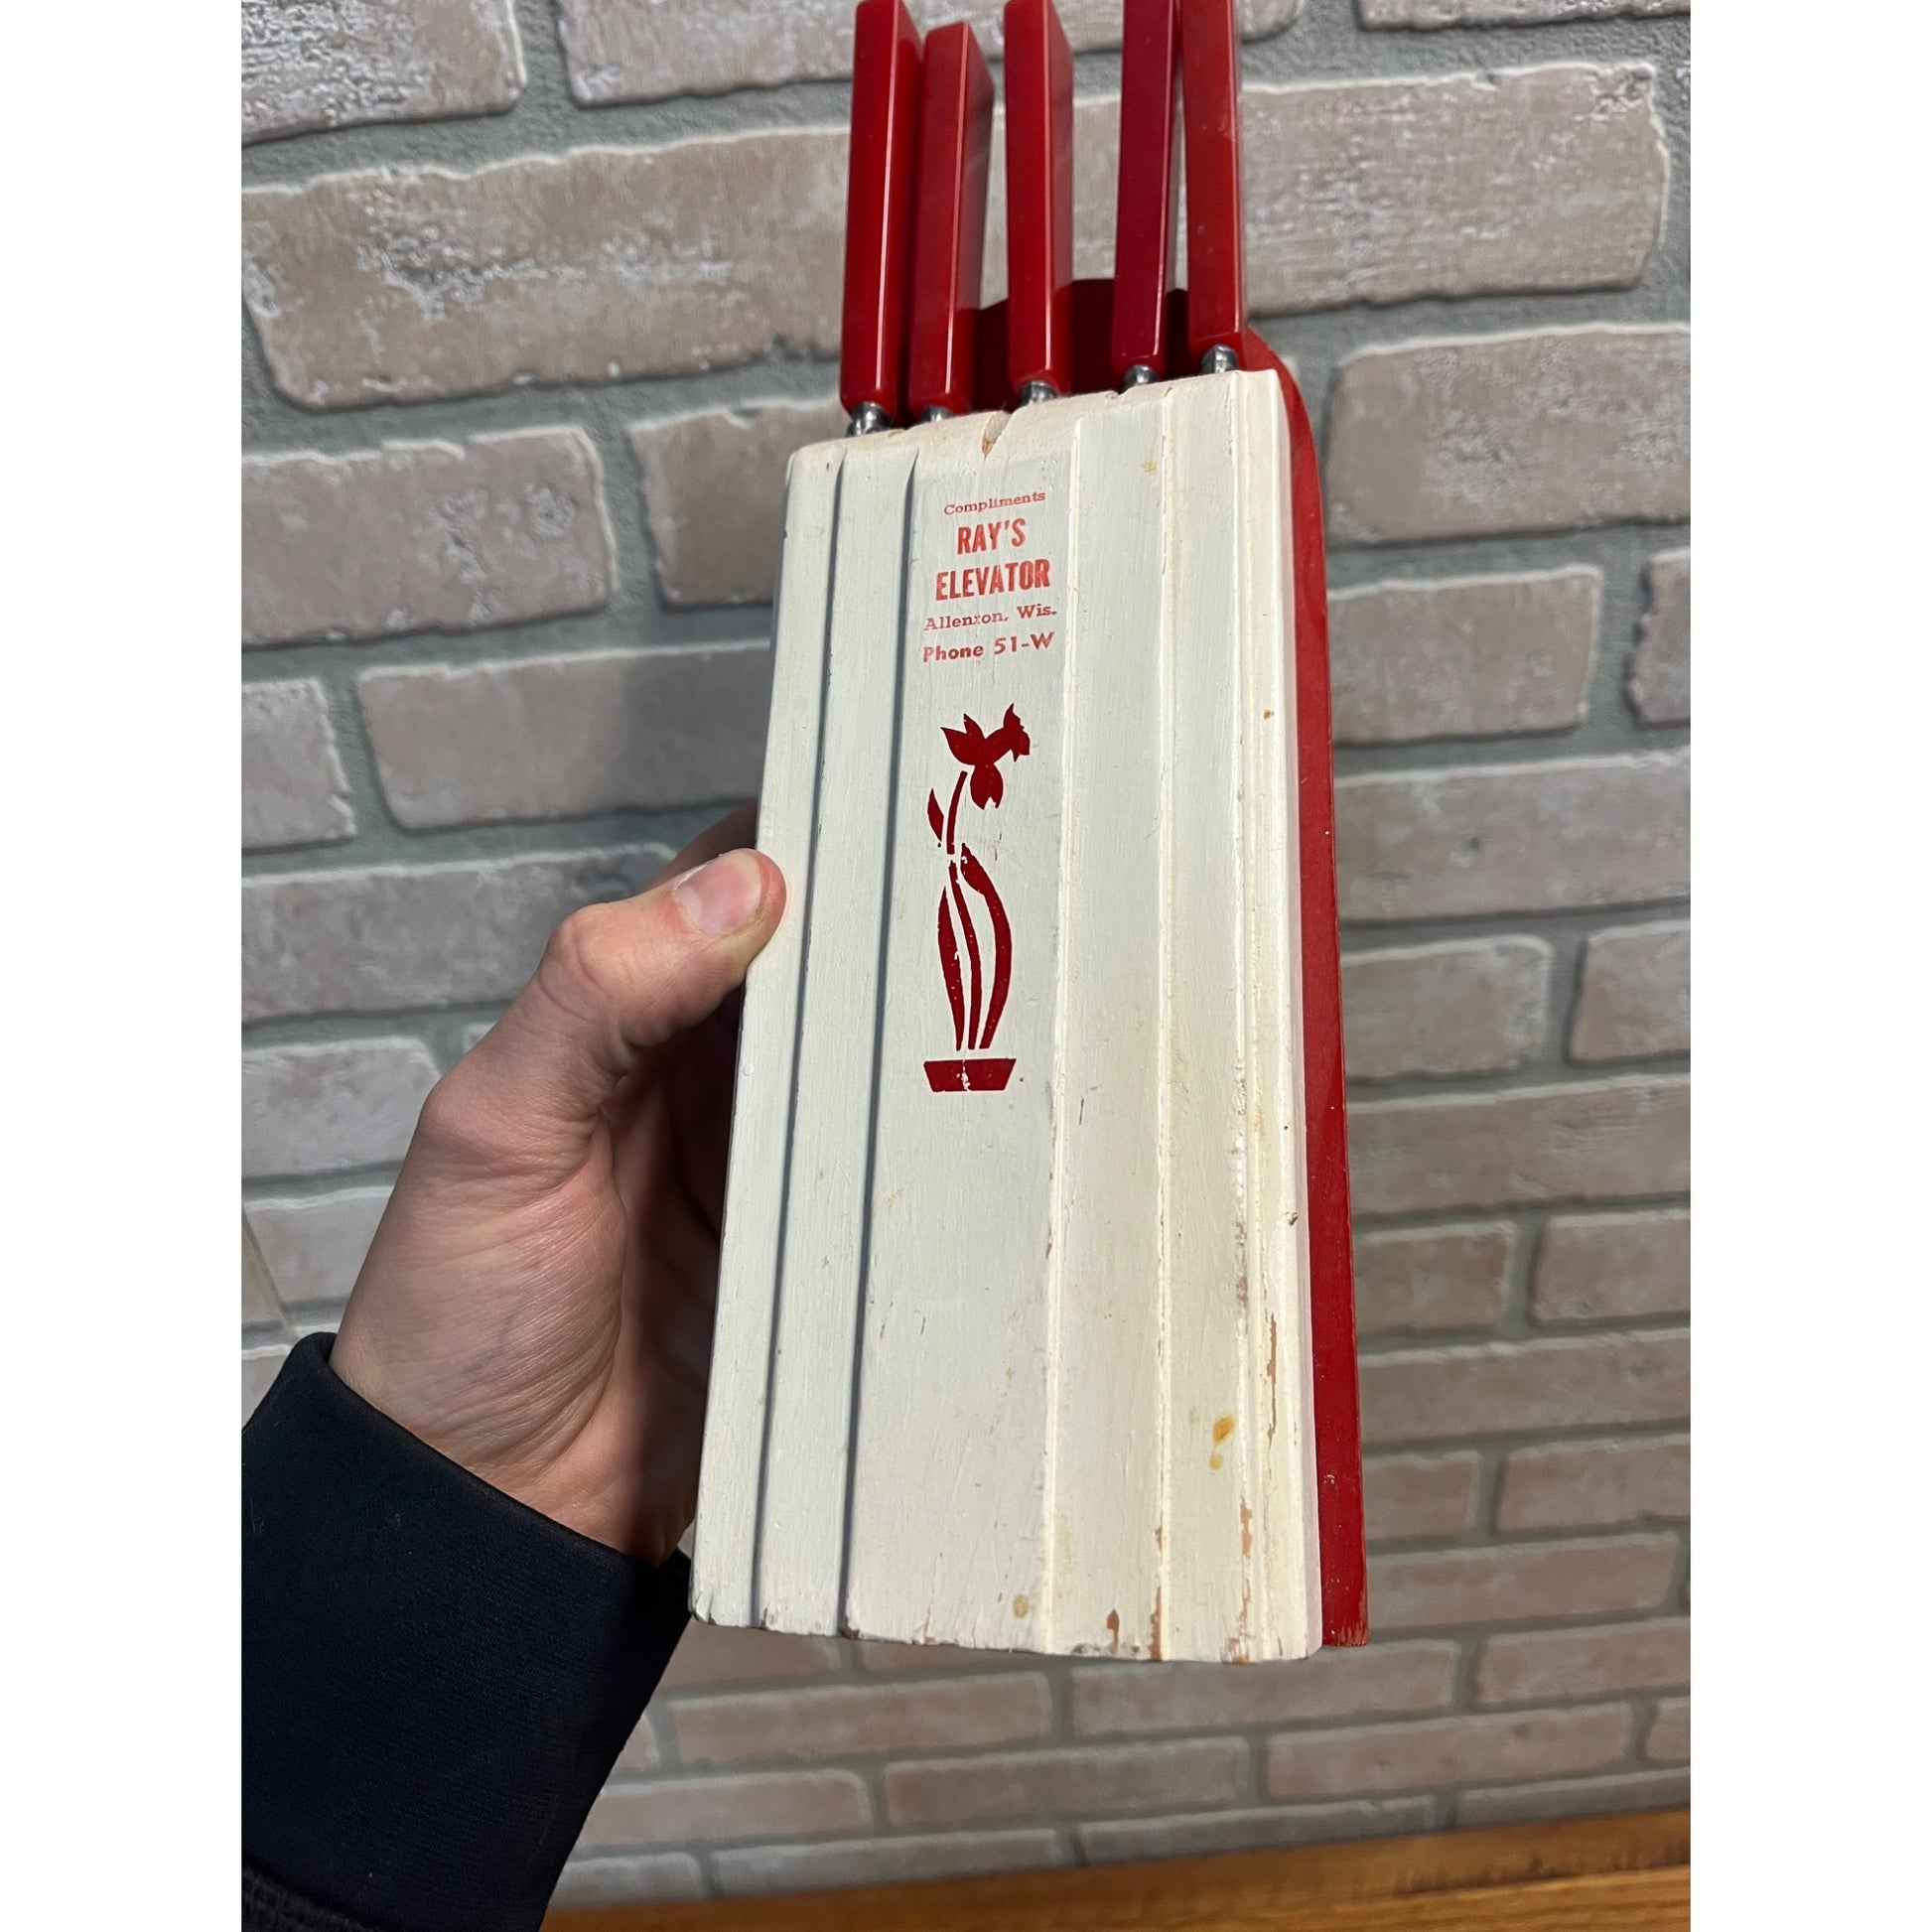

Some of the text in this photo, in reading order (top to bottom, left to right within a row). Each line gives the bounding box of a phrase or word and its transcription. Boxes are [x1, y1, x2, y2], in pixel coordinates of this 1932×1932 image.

[944, 491, 1045, 515] Compliments
[957, 518, 1026, 555] RAY'S
[935, 559, 1050, 601] ELEVATOR
[1017, 604, 1057, 620] Wis.
[922, 632, 1055, 662] Phone 51-W
